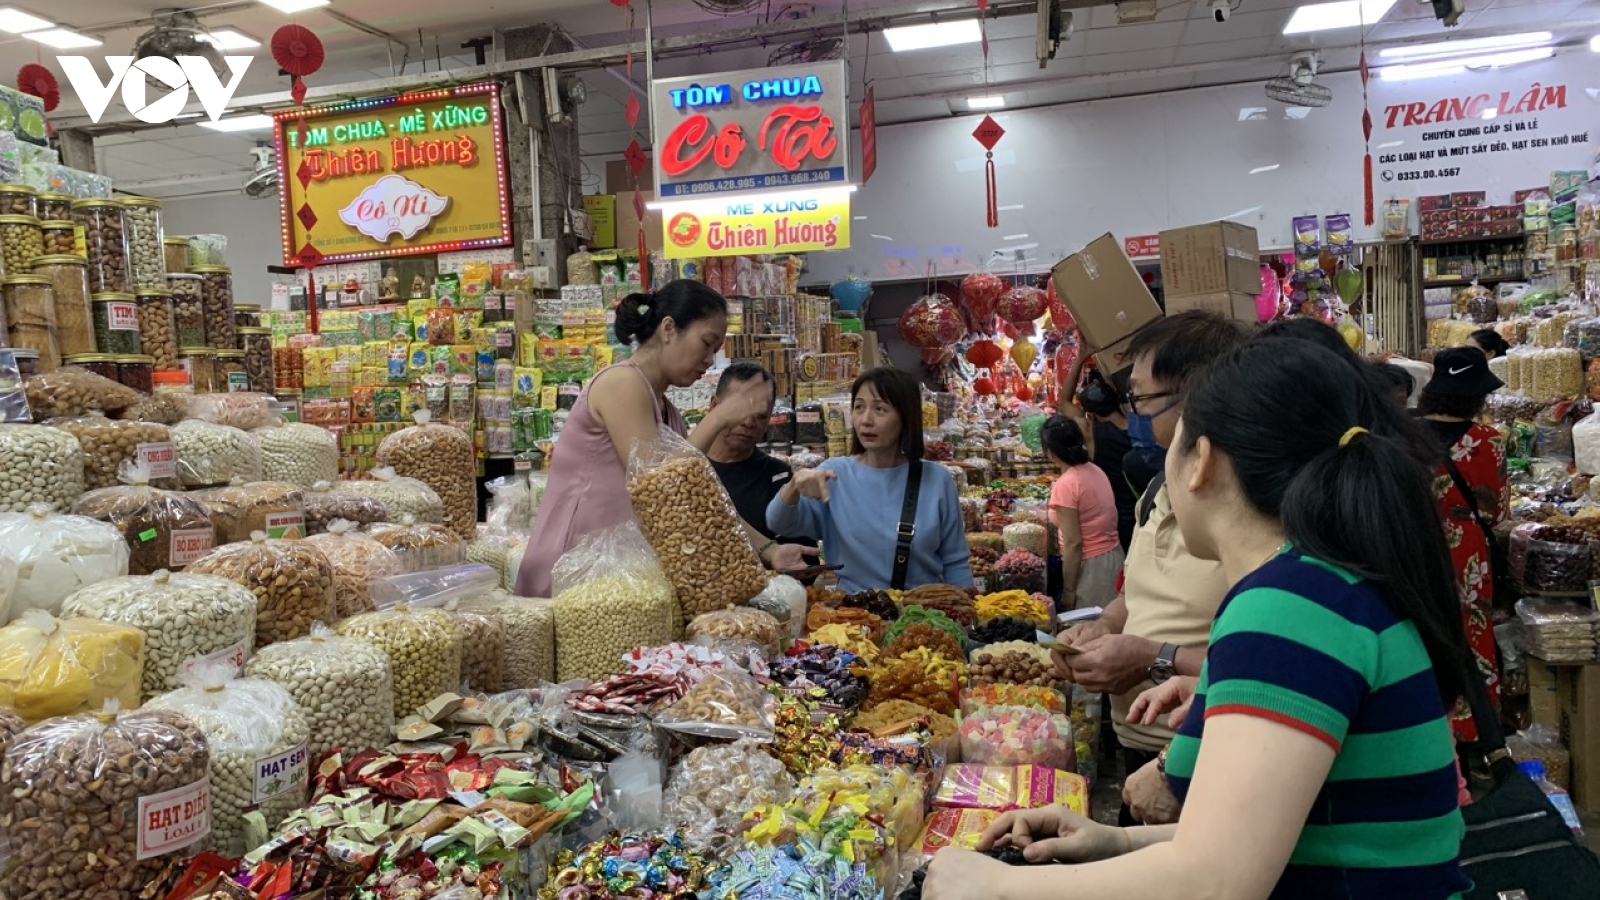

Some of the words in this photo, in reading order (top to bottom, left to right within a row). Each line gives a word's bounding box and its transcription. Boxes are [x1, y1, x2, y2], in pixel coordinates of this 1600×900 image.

[669, 83, 732, 108] TÔM
[742, 75, 823, 102] CHUA
[1384, 93, 1491, 129] TRANG
[1497, 82, 1567, 116] LÂM
[334, 119, 386, 142] CHUA
[399, 108, 426, 133] MÈ
[1457, 126, 1481, 138] CUNG
[1379, 153, 1396, 164] CÁC
[1398, 152, 1418, 163] LOẠI
[1419, 150, 1435, 161] HẠT
[1437, 146, 1449, 158] VÀ
[1511, 139, 1528, 151] HẠT
[1530, 137, 1549, 148] SEN
[691, 178, 756, 194] 0906.428.995
[764, 170, 831, 187] 0943.968.340
[1397, 167, 1461, 181] 0333.00.4567
[357, 199, 387, 222] Cô
[706, 221, 768, 251] Thiên
[114, 306, 133, 318] TIM
[261, 757, 287, 779] HẠT
[290, 747, 306, 768] SEN
[149, 805, 182, 832] HẠT
[163, 824, 195, 842] LOẠI
